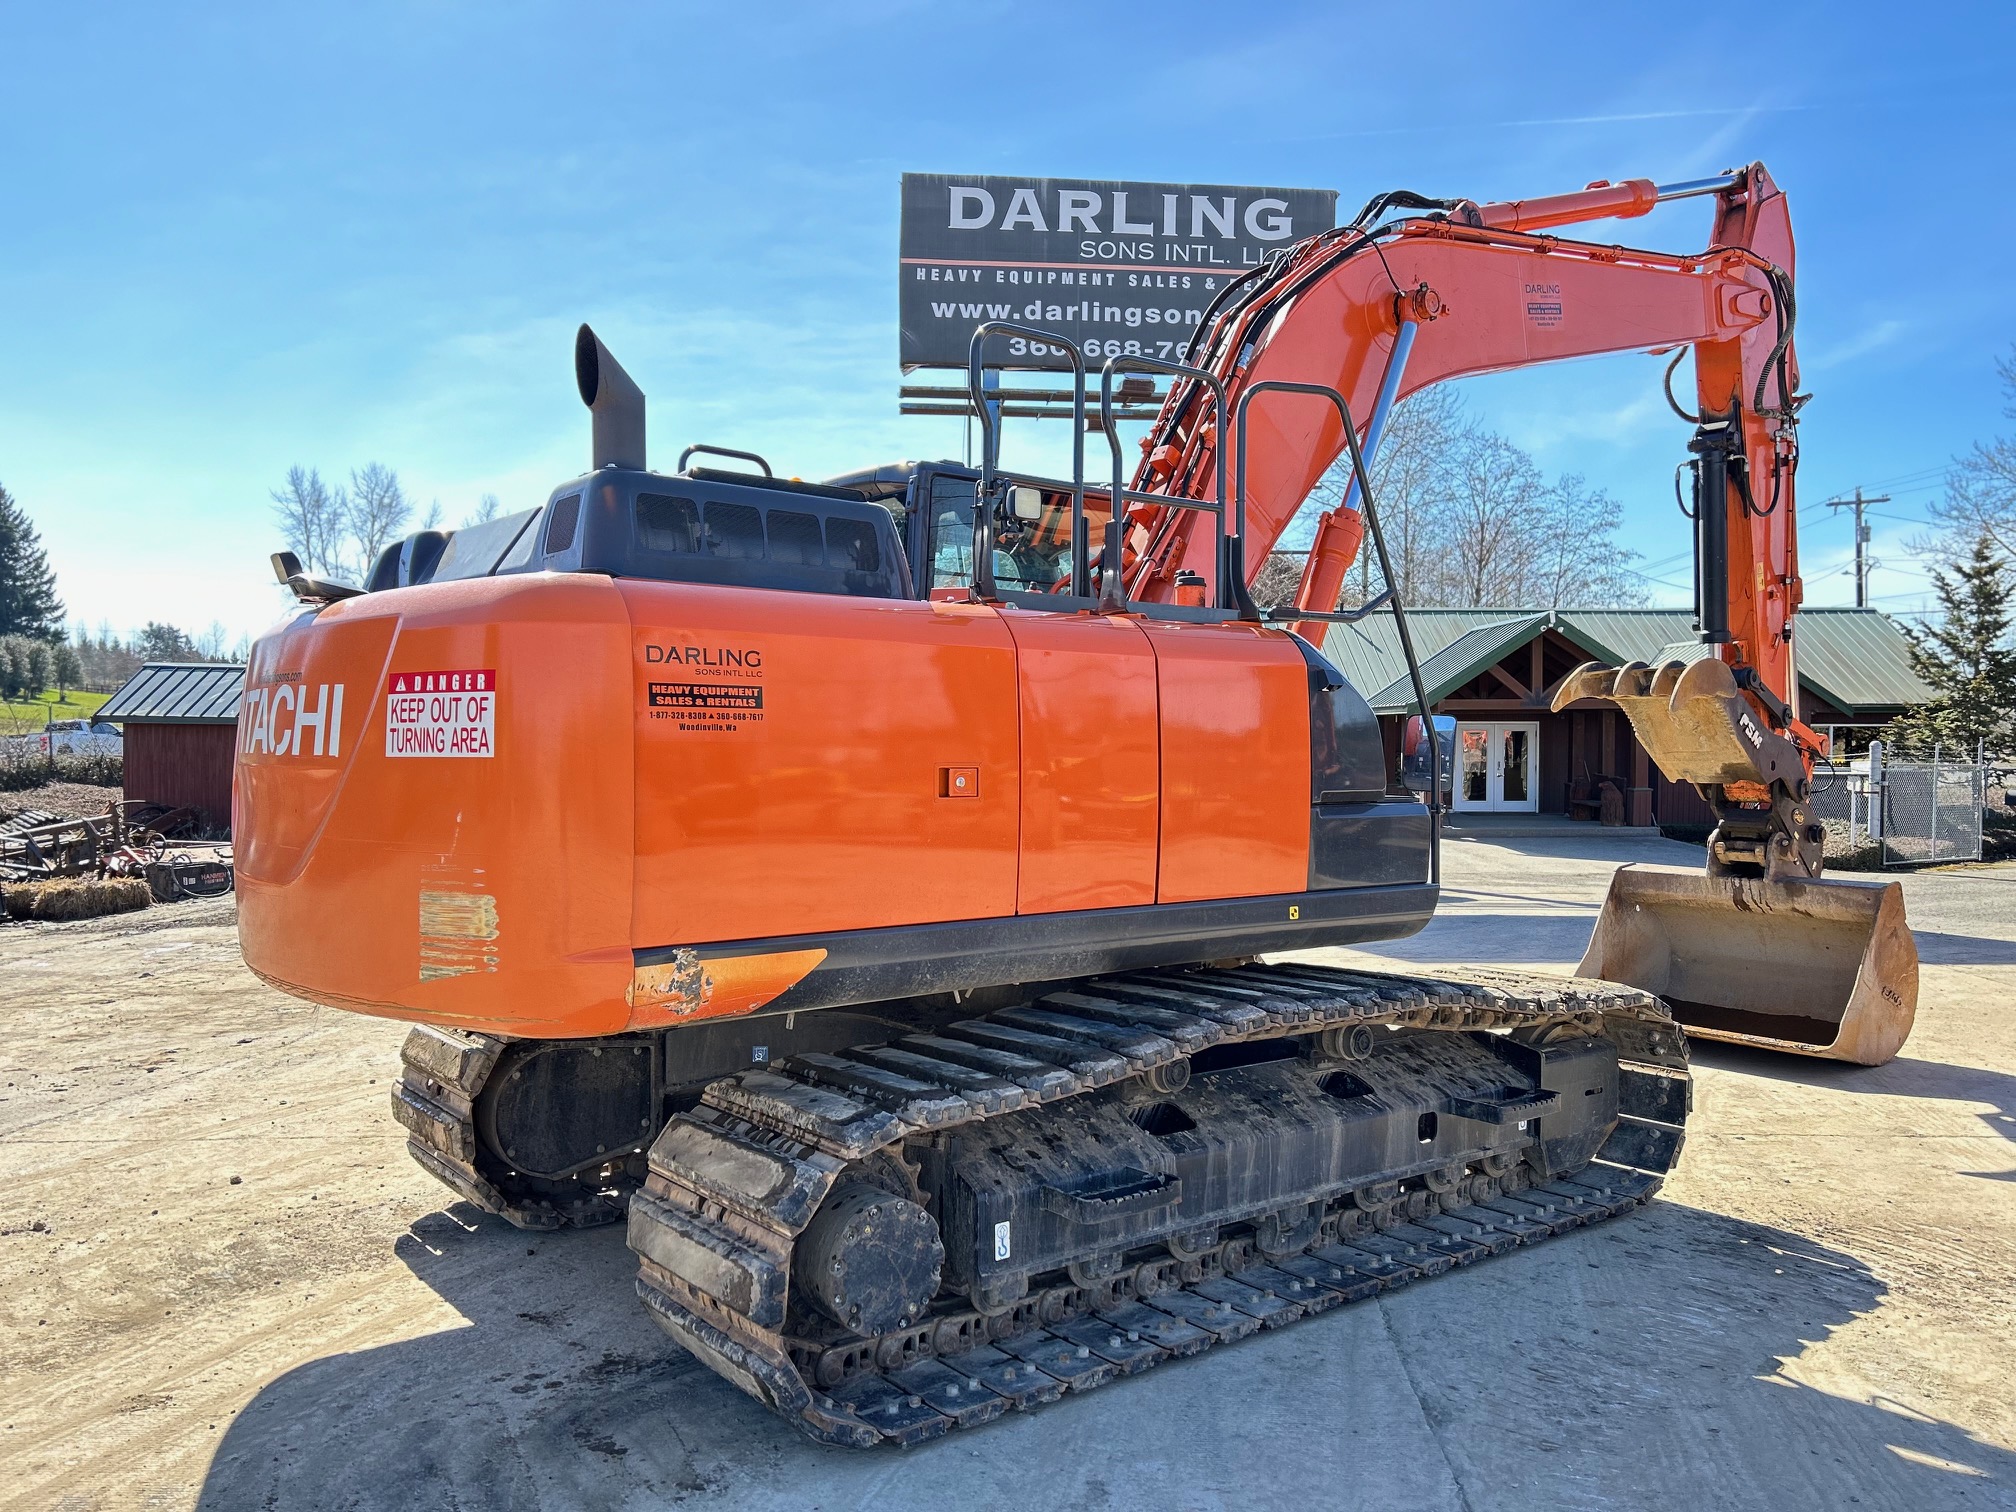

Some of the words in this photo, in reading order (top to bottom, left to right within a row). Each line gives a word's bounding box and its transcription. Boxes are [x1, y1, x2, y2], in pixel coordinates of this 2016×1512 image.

[948, 185, 1293, 241] DARLING
[1080, 240, 1154, 261] SONS
[1165, 243, 1230, 264] INTL.
[916, 267, 982, 283] HEAVY
[996, 270, 1115, 286] EQUIPMENT
[1129, 273, 1191, 289] SALES
[1204, 277, 1216, 290] &
[1525, 284, 1560, 294] DARLING
[645, 644, 762, 668] DARLING
[413, 673, 486, 691] DANGER
[695, 668, 721, 676] SONS
[745, 670, 763, 678] LLC
[652, 685, 691, 695] HEAVY
[693, 686, 760, 697] EQUIPMENT
[656, 696, 693, 706] SALES
[695, 697, 704, 706] &
[706, 697, 756, 707] RENTALS
[391, 697, 426, 723] KEEP
[430, 696, 462, 723] OUT
[466, 696, 489, 723] OF
[389, 727, 445, 753] TURNING
[450, 727, 490, 754] AREA
